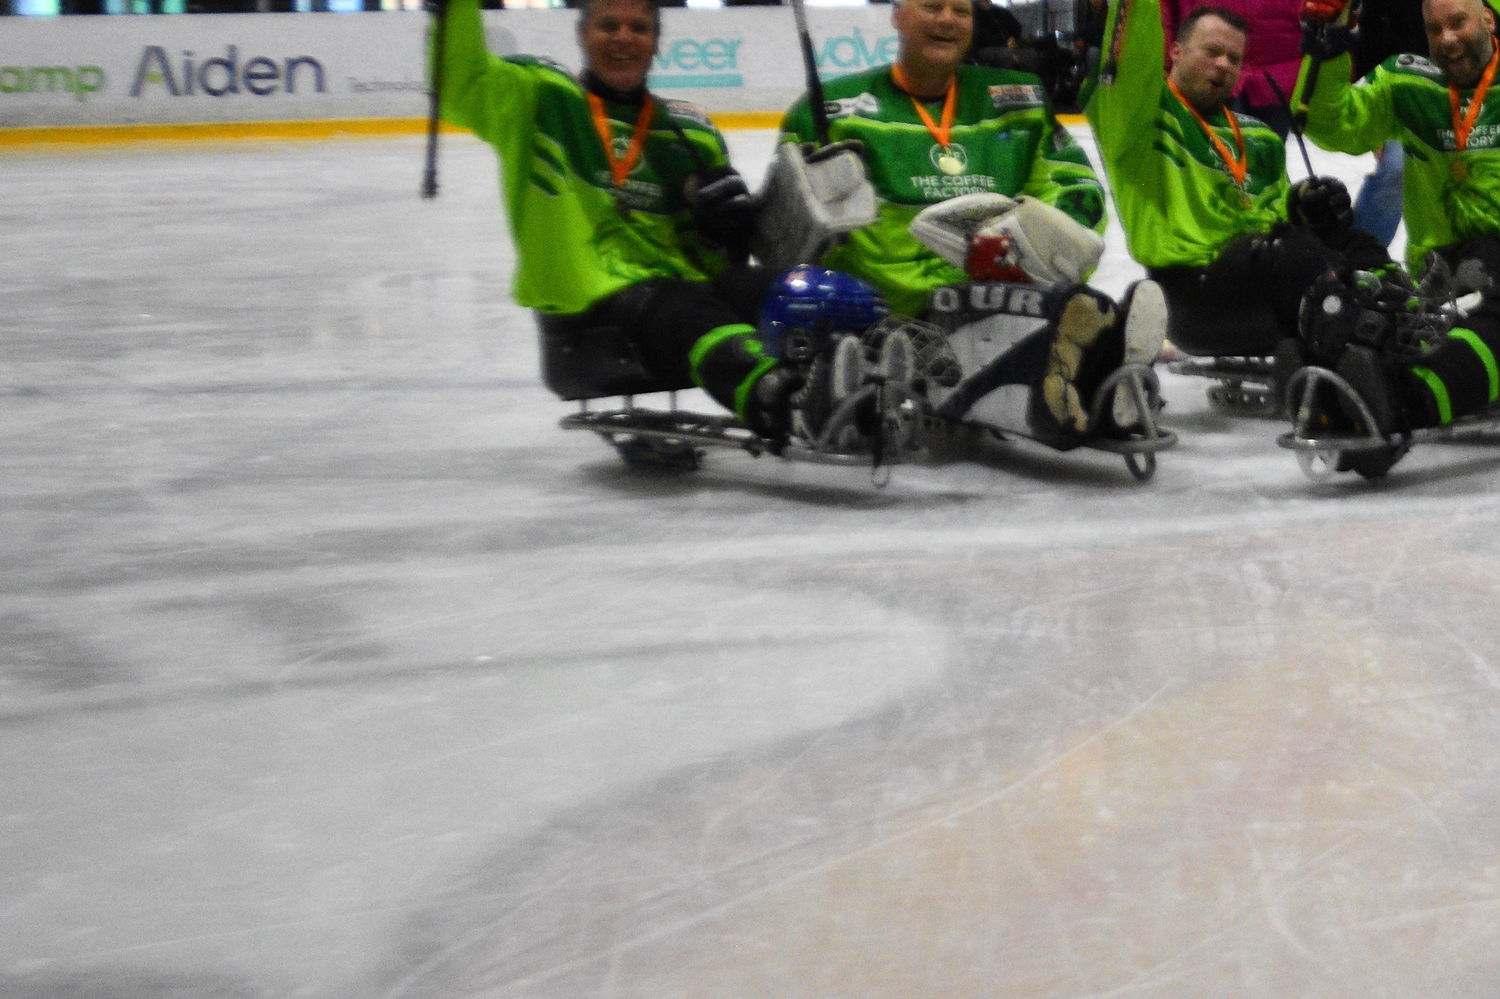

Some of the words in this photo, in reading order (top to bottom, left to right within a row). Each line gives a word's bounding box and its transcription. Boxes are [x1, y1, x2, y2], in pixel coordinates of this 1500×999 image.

[129, 45, 325, 97] Aiden
[911, 175, 939, 187] THE
[942, 174, 996, 187] COFFEE
